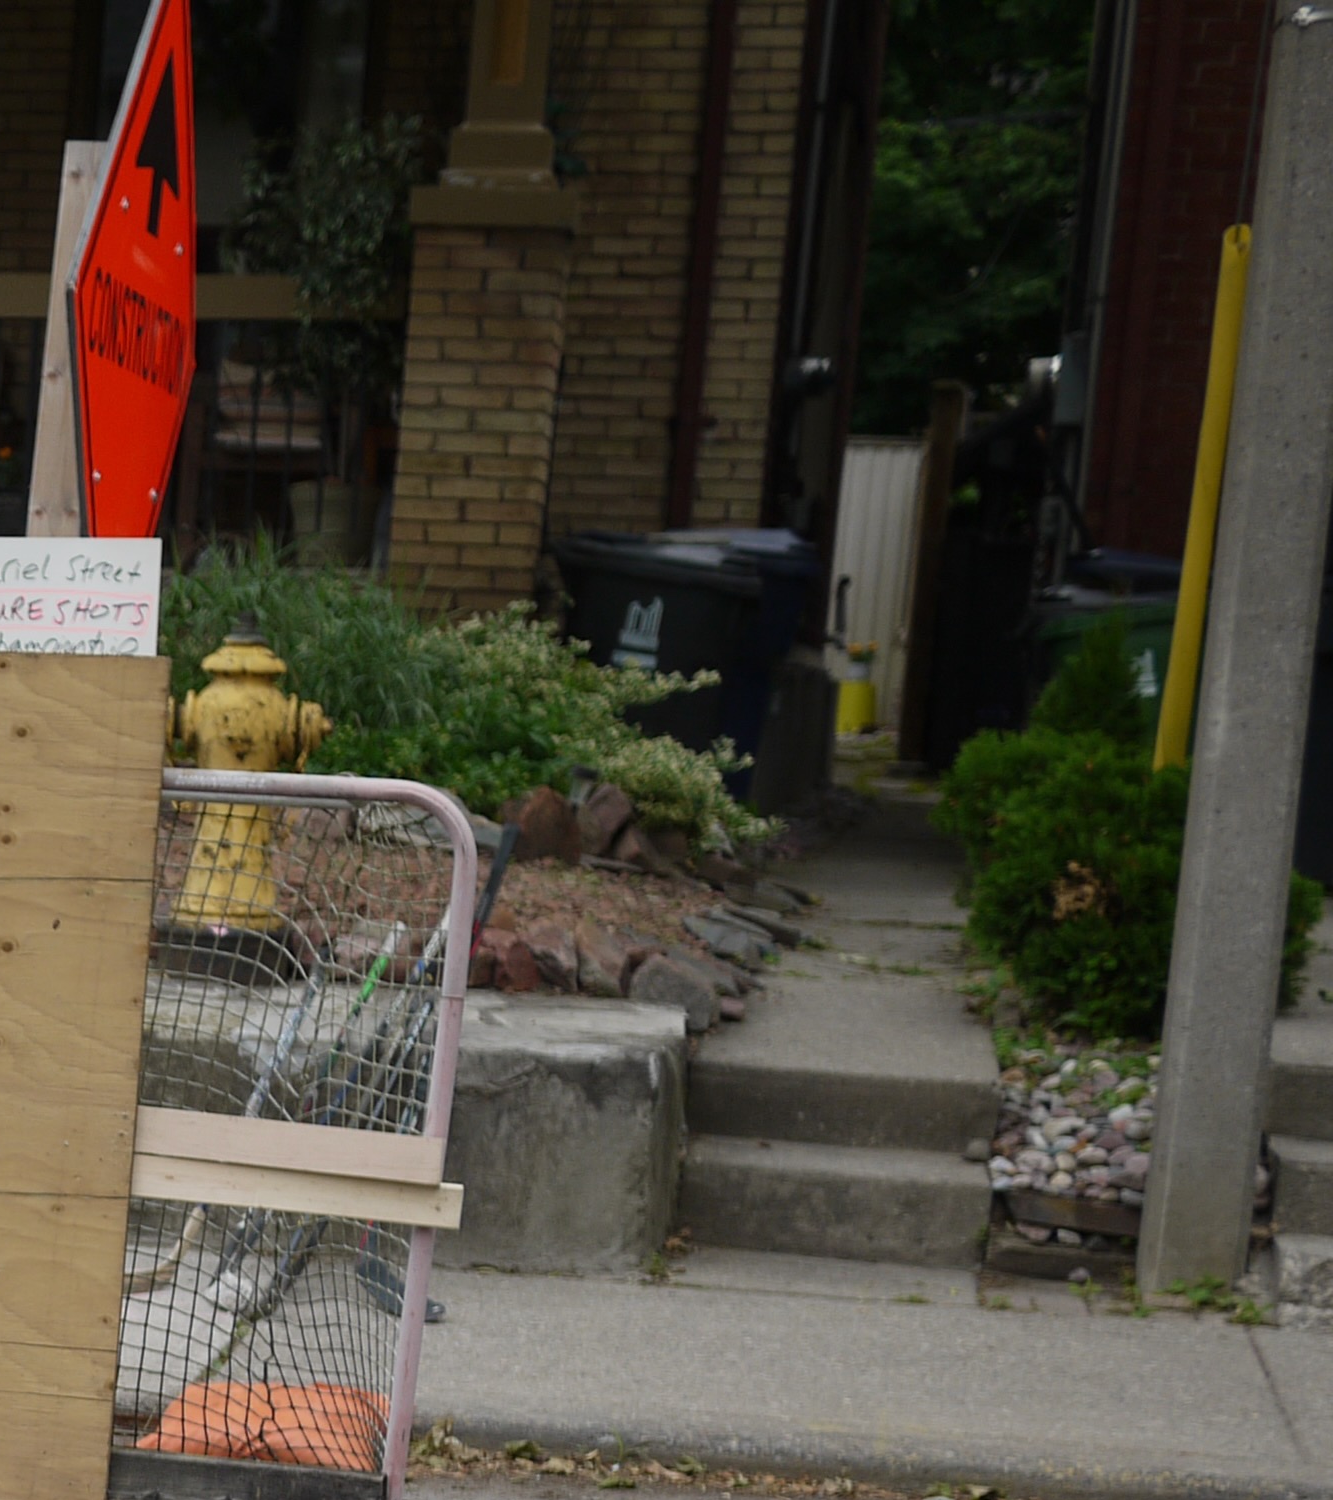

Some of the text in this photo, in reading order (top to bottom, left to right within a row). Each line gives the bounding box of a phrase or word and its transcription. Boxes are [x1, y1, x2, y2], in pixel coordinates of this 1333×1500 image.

[89, 267, 188, 394] CONSTRUCTION
[66, 554, 142, 583] Street
[53, 597, 149, 627] SHOTS
